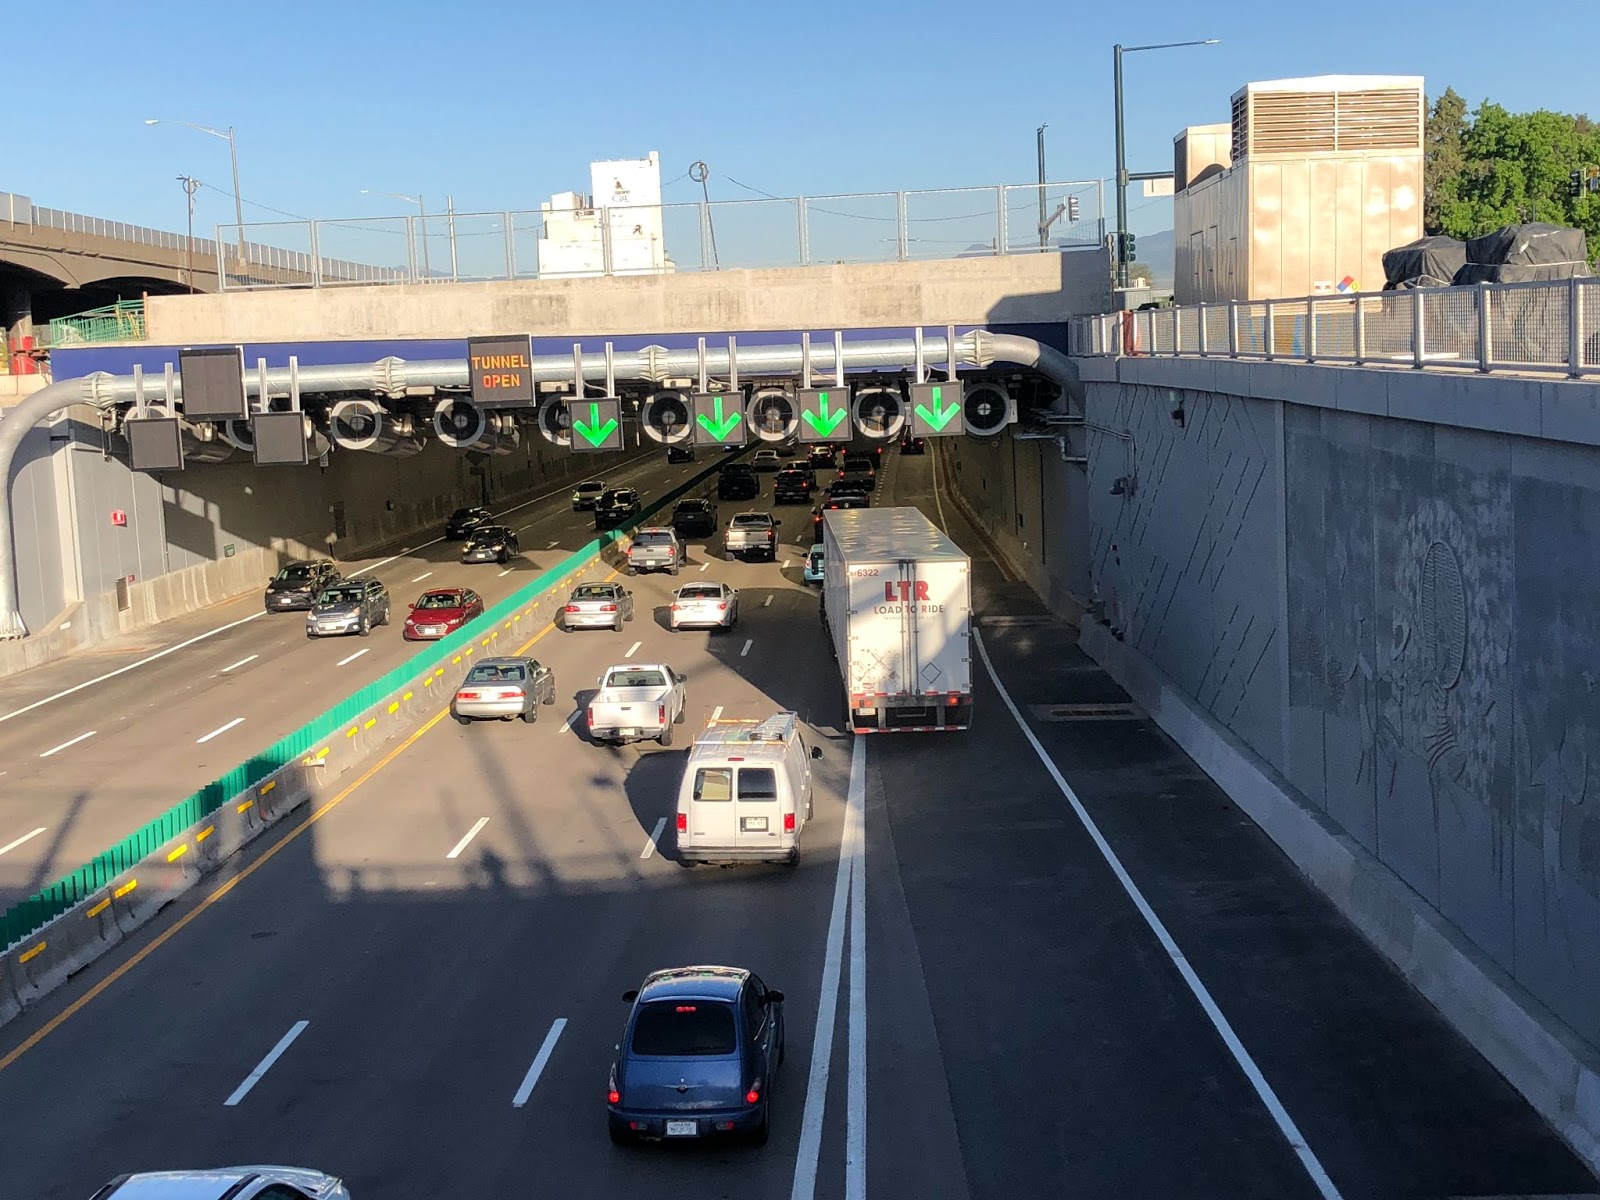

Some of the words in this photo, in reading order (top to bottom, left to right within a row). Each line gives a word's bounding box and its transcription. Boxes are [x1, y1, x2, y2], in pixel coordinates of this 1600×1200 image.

[471, 354, 529, 370] TUNNEL
[483, 373, 520, 388] OPEN
[857, 568, 879, 577] 6322
[884, 580, 931, 602] LTR
[874, 605, 902, 615] LOAD
[904, 604, 918, 613] TO
[921, 604, 944, 613] RIDE
